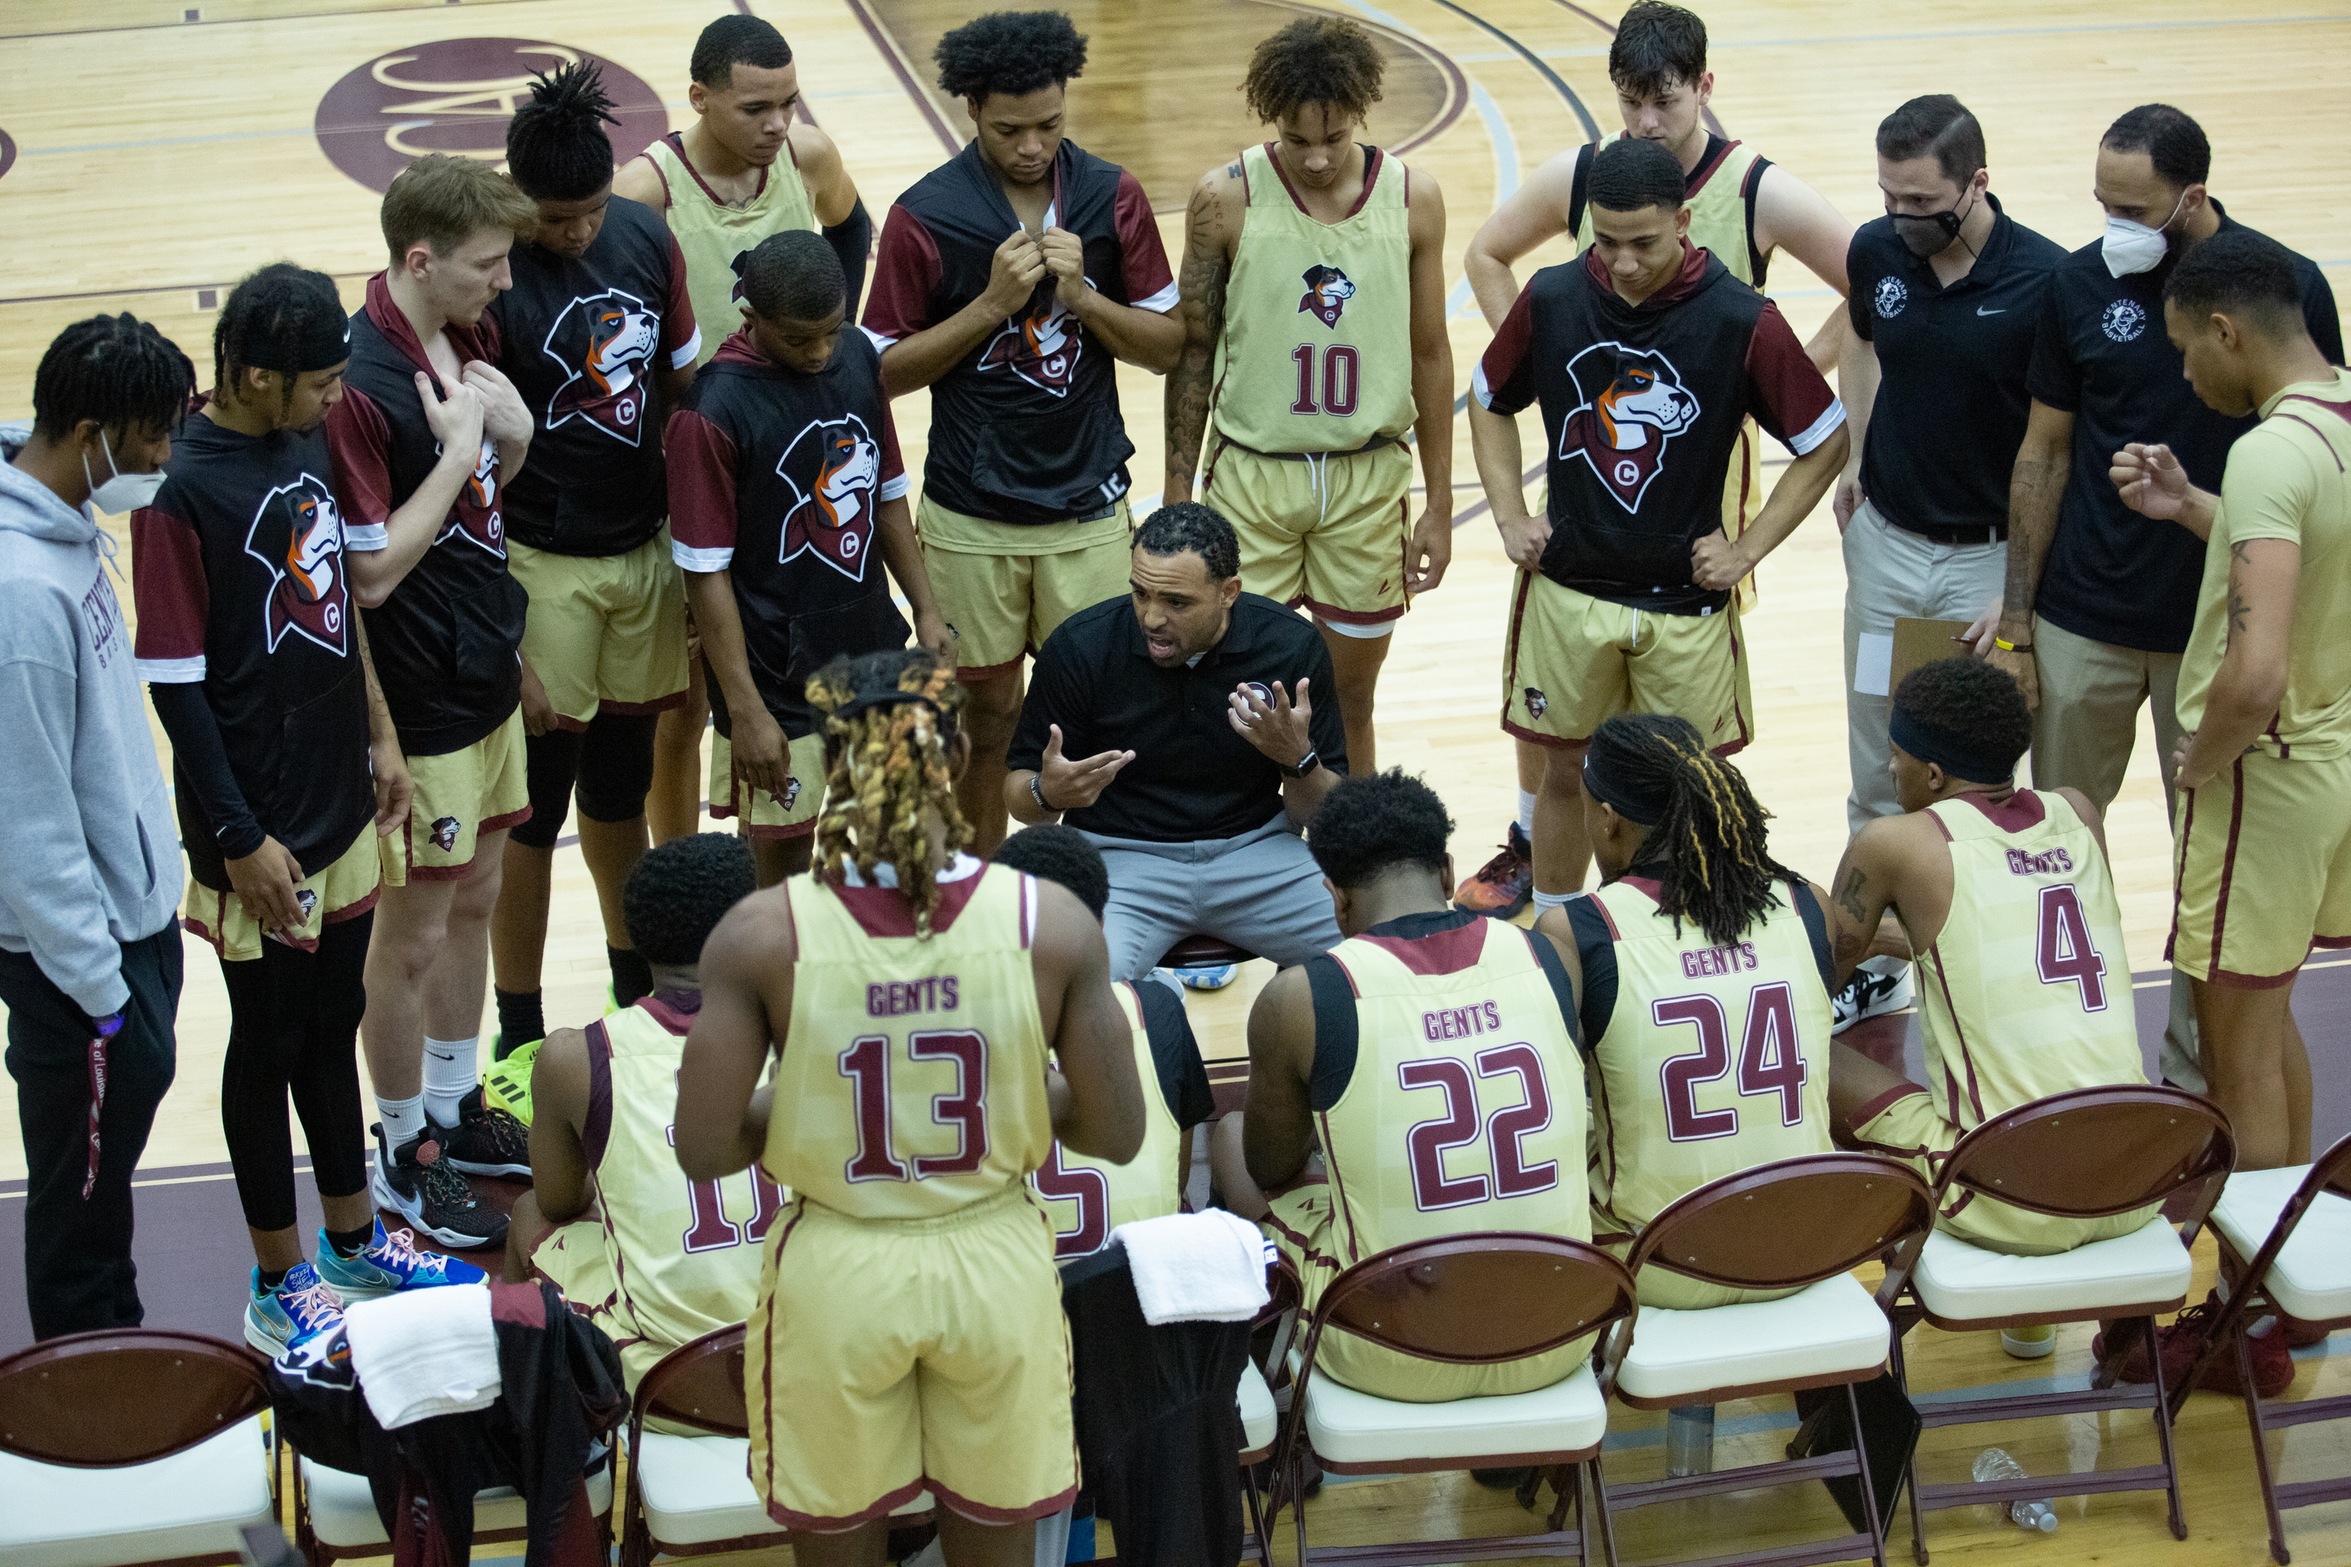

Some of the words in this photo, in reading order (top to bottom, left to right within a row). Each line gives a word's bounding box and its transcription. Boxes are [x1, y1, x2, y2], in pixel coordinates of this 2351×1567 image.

[1875, 276, 1907, 300] CENTENARY
[1875, 297, 1906, 319] BASKETBALL
[2102, 299, 2146, 320] CENTENARY
[2101, 322, 2146, 342] BASKETBALL
[1290, 343, 1360, 417] 10
[2004, 847, 2074, 876] GENTS
[1680, 941, 1759, 979] GENTS
[2035, 883, 2108, 1013] 4
[867, 975, 959, 1018] GENTS
[1422, 999, 1501, 1042] GENTS
[94, 1050, 105, 1062] of
[1651, 981, 1807, 1143] 24
[838, 1028, 990, 1184] 13
[1397, 1041, 1558, 1213] 22
